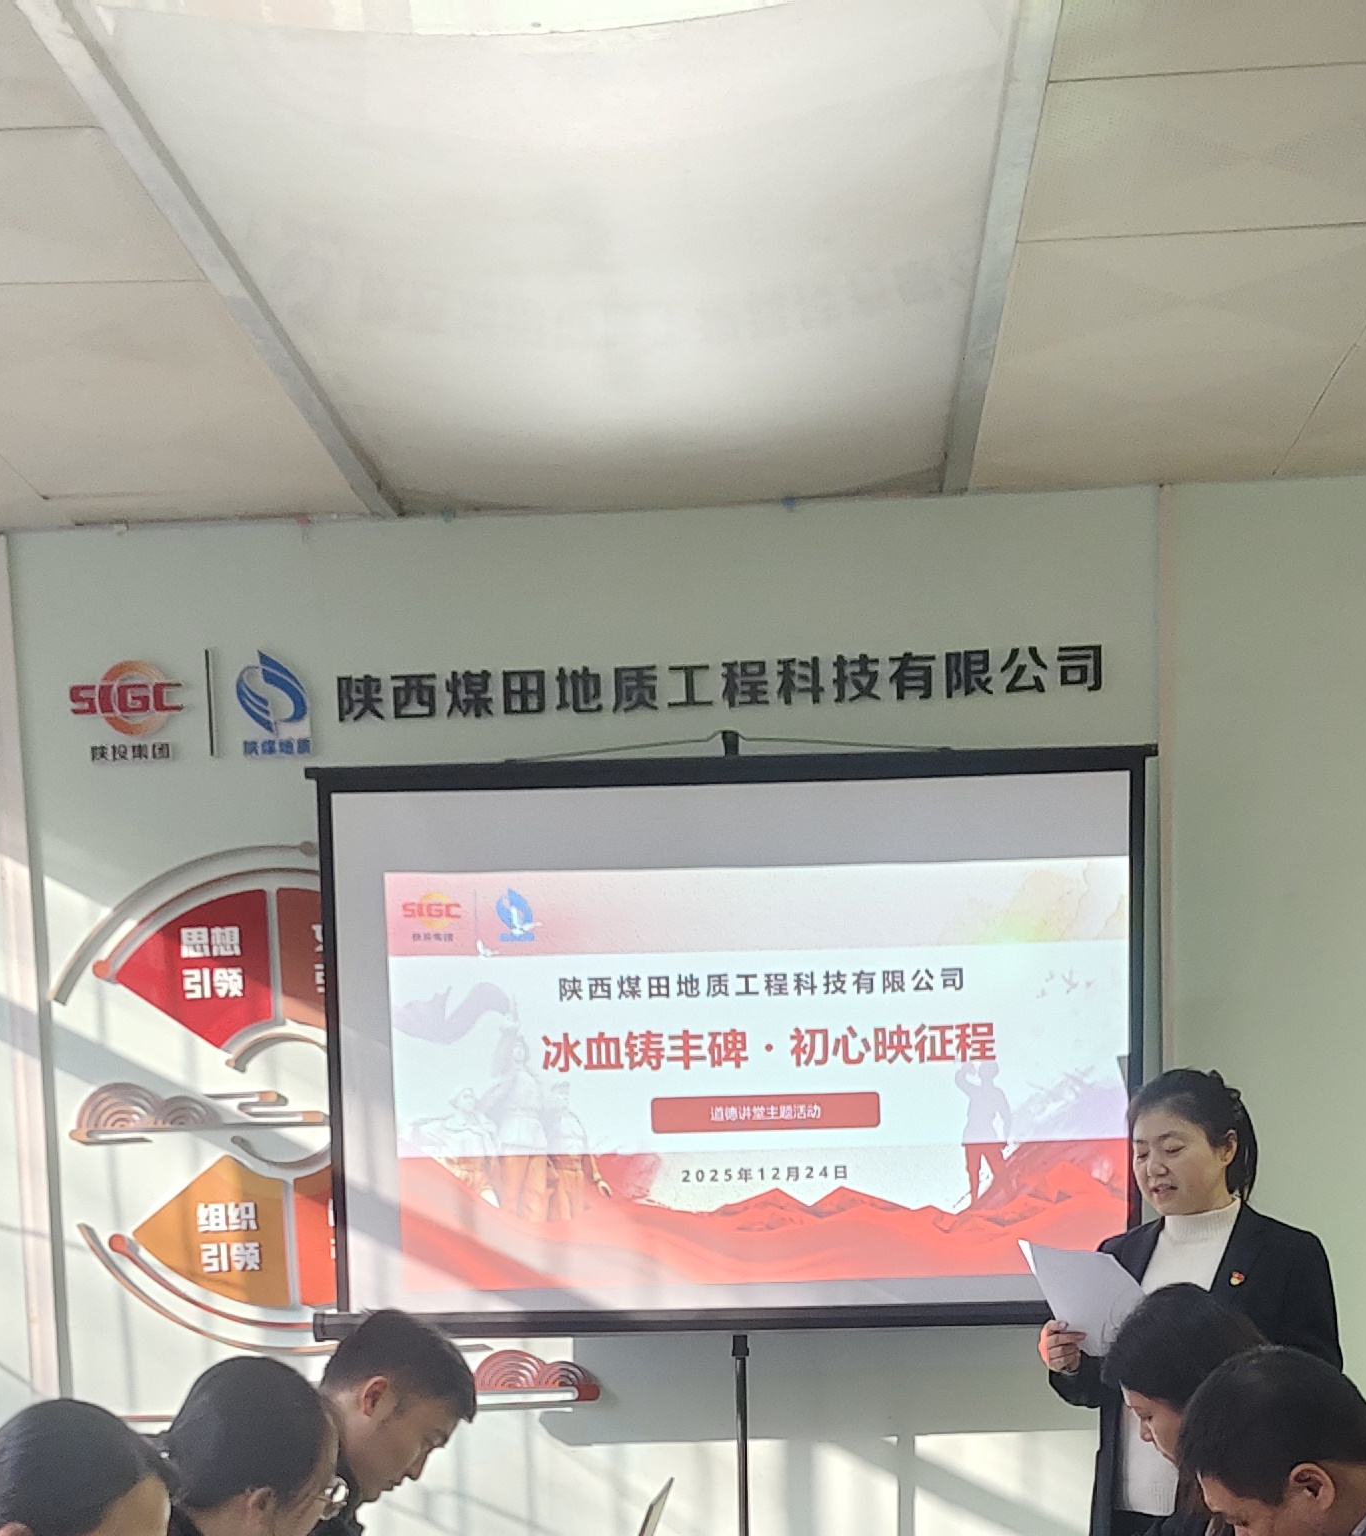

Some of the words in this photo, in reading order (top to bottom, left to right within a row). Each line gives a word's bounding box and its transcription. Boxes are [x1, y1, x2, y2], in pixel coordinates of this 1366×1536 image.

[69, 681, 185, 715] SIGC
[337, 643, 1105, 723] 陕西煤田地质工程科技有限公司
[90, 743, 171, 762] 陕投集团
[401, 901, 462, 919] SIGC
[180, 926, 241, 957] 思想
[182, 968, 244, 999] 引领
[558, 966, 966, 1002] 陕西煤田地质工程科技有限公司
[541, 1021, 997, 1073] 冰血铸丰碑·初心映征程
[709, 1103, 822, 1122] 道德讲堂主题活动
[681, 1164, 849, 1184] 2025年12月24日
[195, 1202, 258, 1233] 组织
[200, 1242, 261, 1273] 引领
